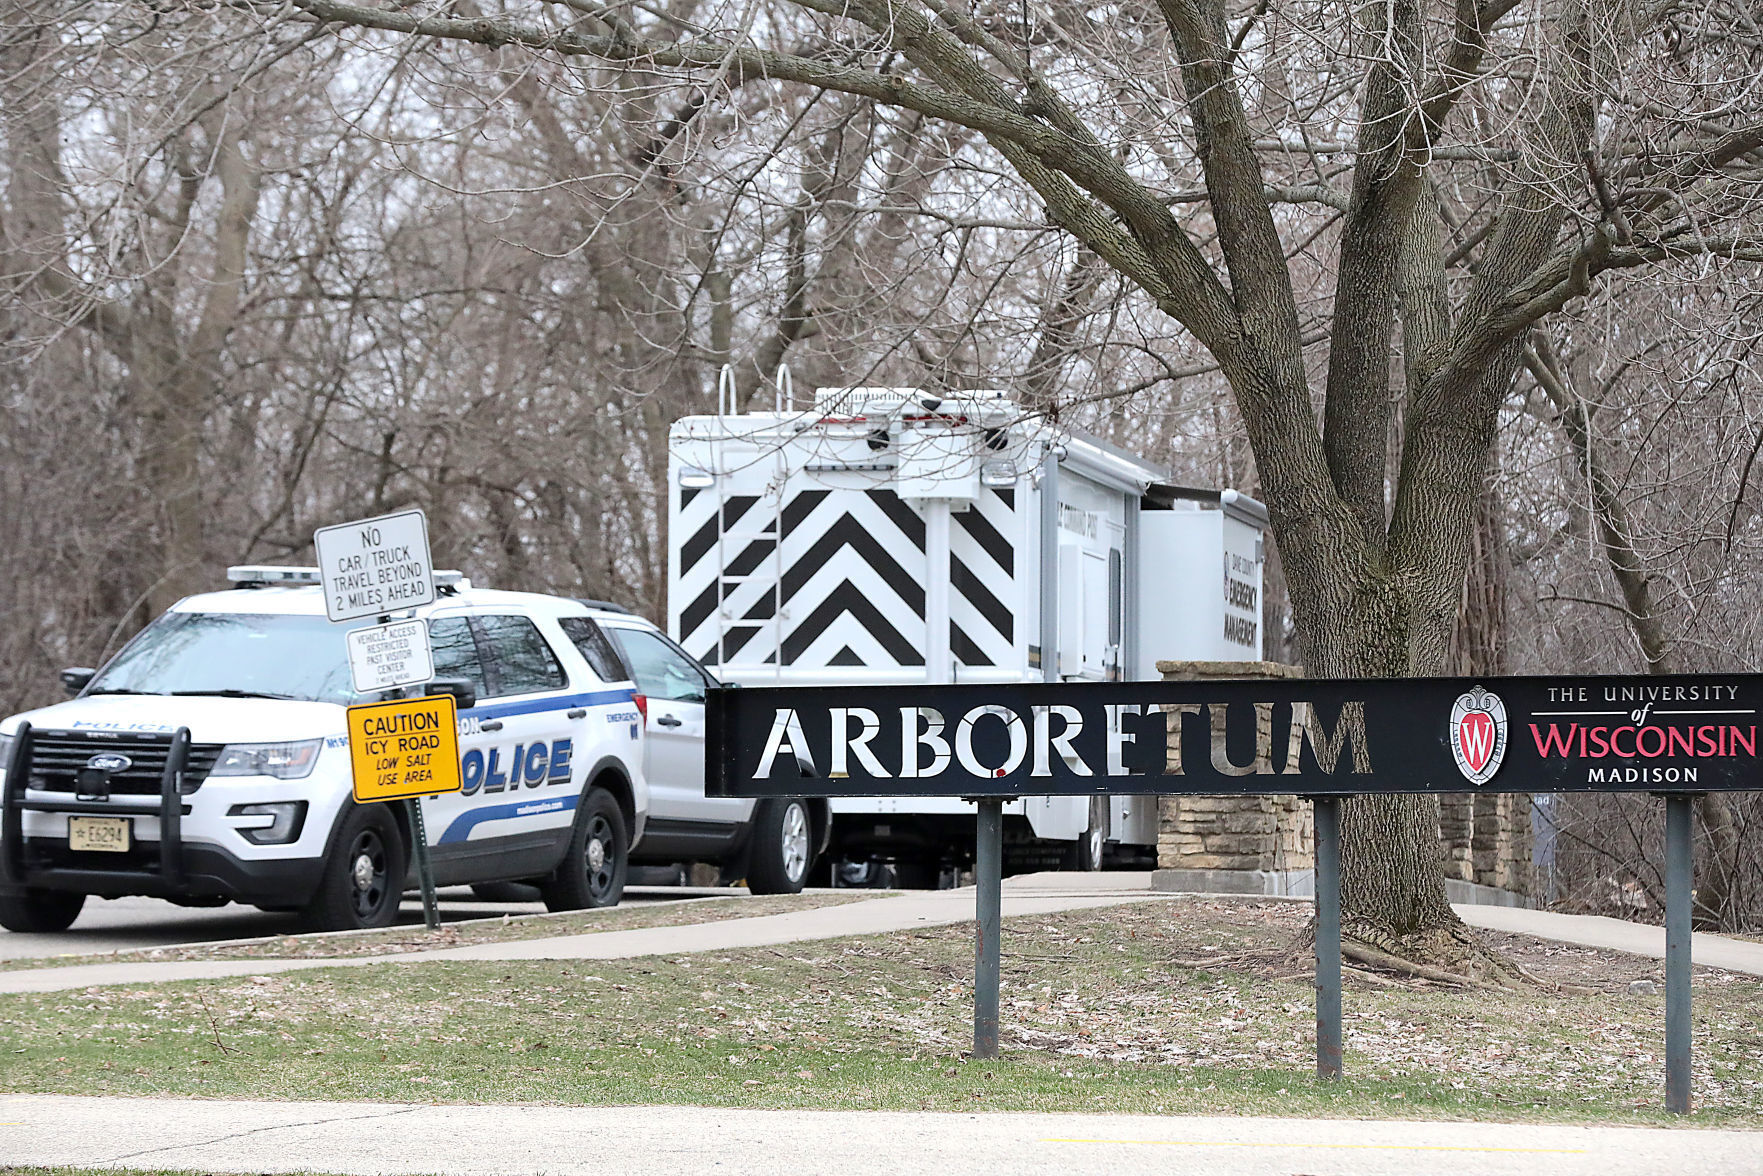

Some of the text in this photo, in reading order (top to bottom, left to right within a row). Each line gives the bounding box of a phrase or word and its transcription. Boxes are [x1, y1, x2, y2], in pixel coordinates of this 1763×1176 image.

[361, 528, 381, 548] NO
[338, 545, 411, 573] CAR/TRUCK
[333, 562, 422, 592] TRAVEL BEYOND
[336, 581, 425, 611] 2 MILES AHEAD
[357, 626, 416, 644] VEHICLE ACCESS
[367, 639, 409, 653] RESTRICTED
[367, 649, 412, 665] PAST VISITOR
[377, 661, 405, 675] CENTER
[1548, 685, 1740, 702] THE UNIVERSITY
[363, 711, 439, 736] CAUTION
[606, 712, 638, 723] EMERGENCY
[1630, 702, 1654, 727] of
[73, 720, 174, 732] POLICE
[365, 735, 440, 755] ICY ROAD
[751, 701, 1373, 779] ARBORETUM
[1462, 719, 1491, 765] W
[1528, 723, 1757, 759] WISCONSIN
[376, 753, 432, 770] LOW SALT
[460, 737, 574, 797] OLICE
[377, 769, 433, 786] USE AREA
[1587, 767, 1699, 783] MADISON
[89, 826, 121, 842] E6294
